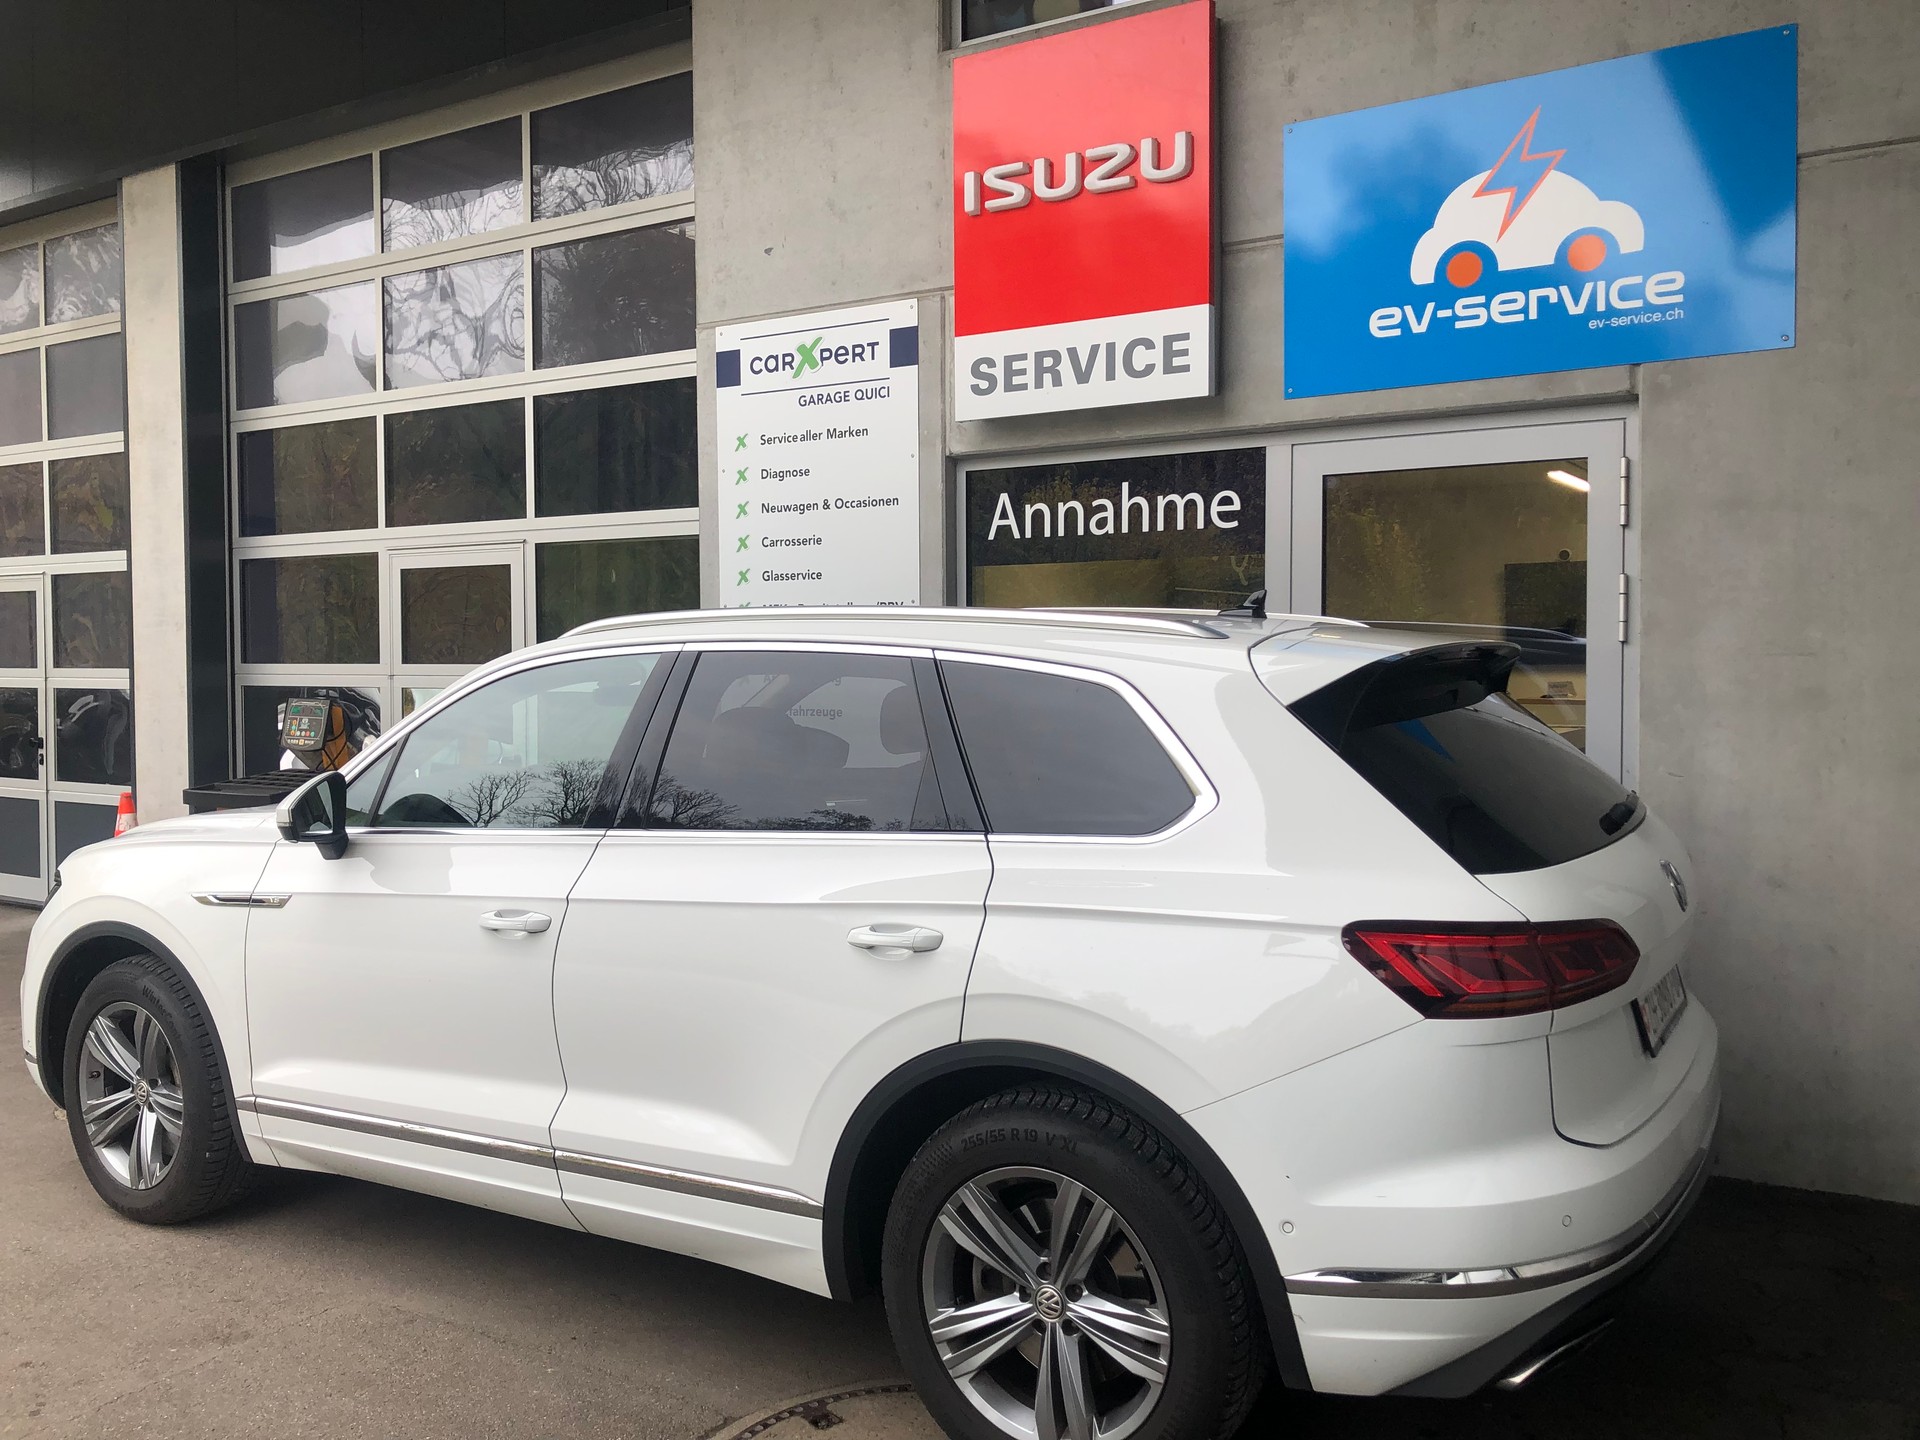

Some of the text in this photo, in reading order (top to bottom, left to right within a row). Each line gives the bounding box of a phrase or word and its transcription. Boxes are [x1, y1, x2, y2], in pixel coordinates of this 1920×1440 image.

[963, 130, 1194, 216] ISUZU
[1368, 270, 1686, 339] ev-service
[1588, 306, 1684, 331] ev-service.ch
[969, 331, 1191, 398] SERVICE
[798, 386, 890, 408] GARAGE QUICI
[760, 426, 869, 446] Service aller Marken
[760, 466, 811, 483] Diagnose
[760, 495, 900, 515] Neuwagen & Occasionen
[987, 481, 1242, 541] Annahme
[761, 535, 823, 549] Carrosserie
[761, 569, 823, 583] Glasservice
[788, 706, 843, 720] fahrzeuge
[1023, 1128, 1039, 1143] 19
